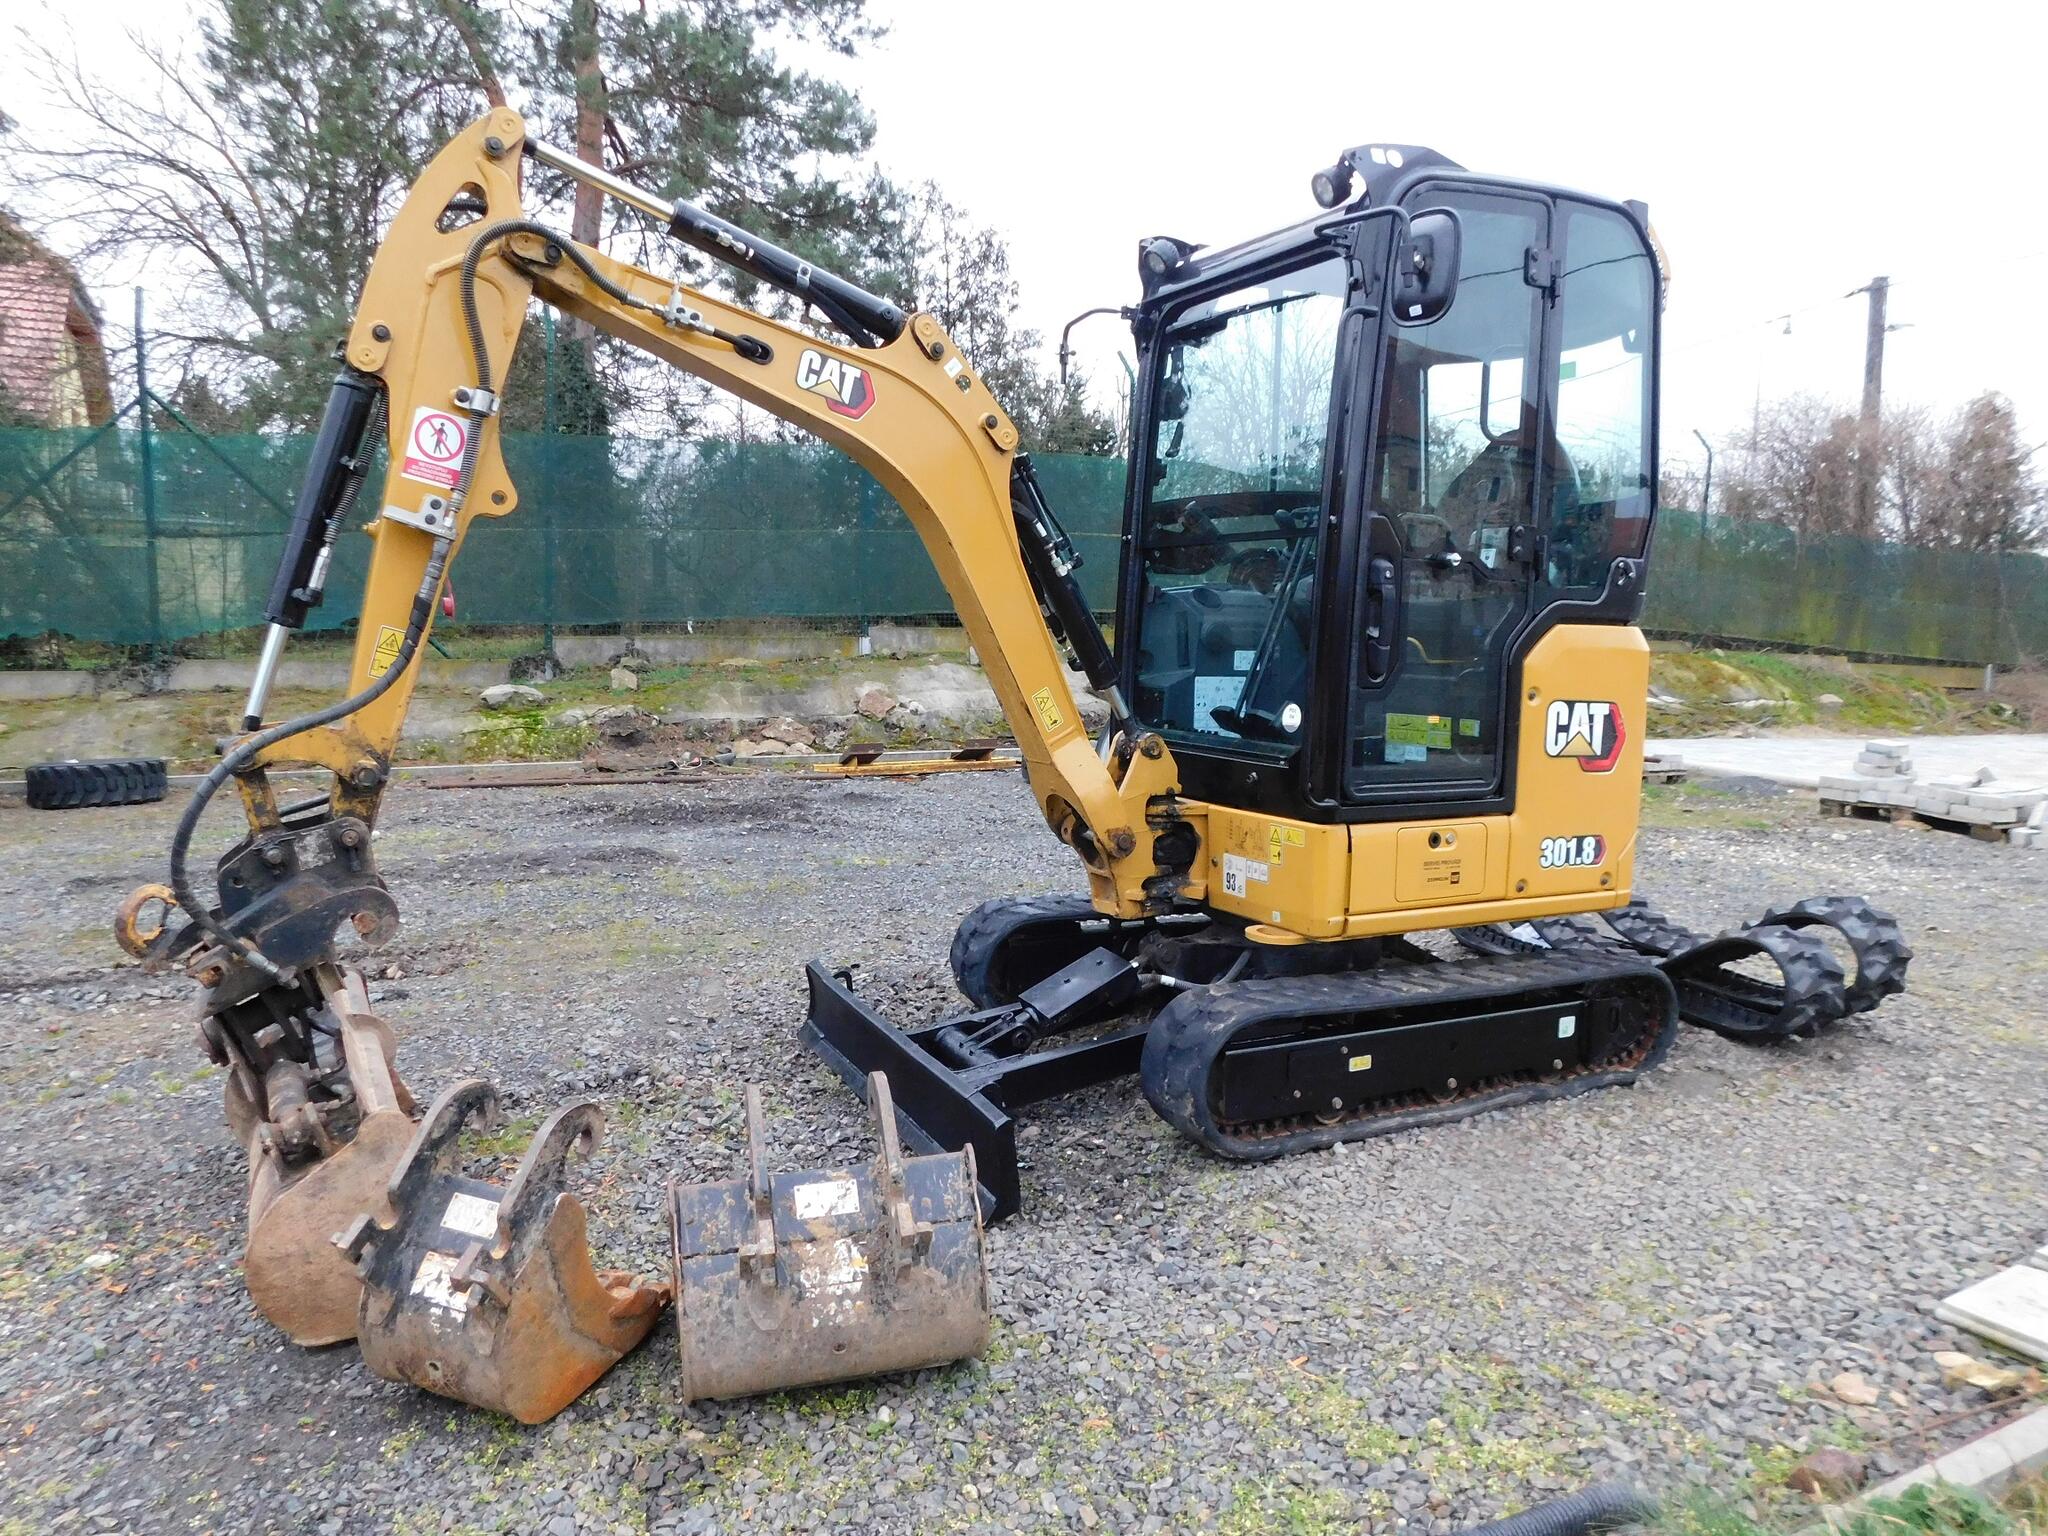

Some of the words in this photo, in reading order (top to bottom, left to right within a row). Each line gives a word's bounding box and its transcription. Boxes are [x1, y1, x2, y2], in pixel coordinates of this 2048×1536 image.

[796, 348, 862, 405] CAT
[1545, 700, 1610, 756] CAT
[1540, 836, 1596, 867] 301.8
[1226, 871, 1237, 892] 93
